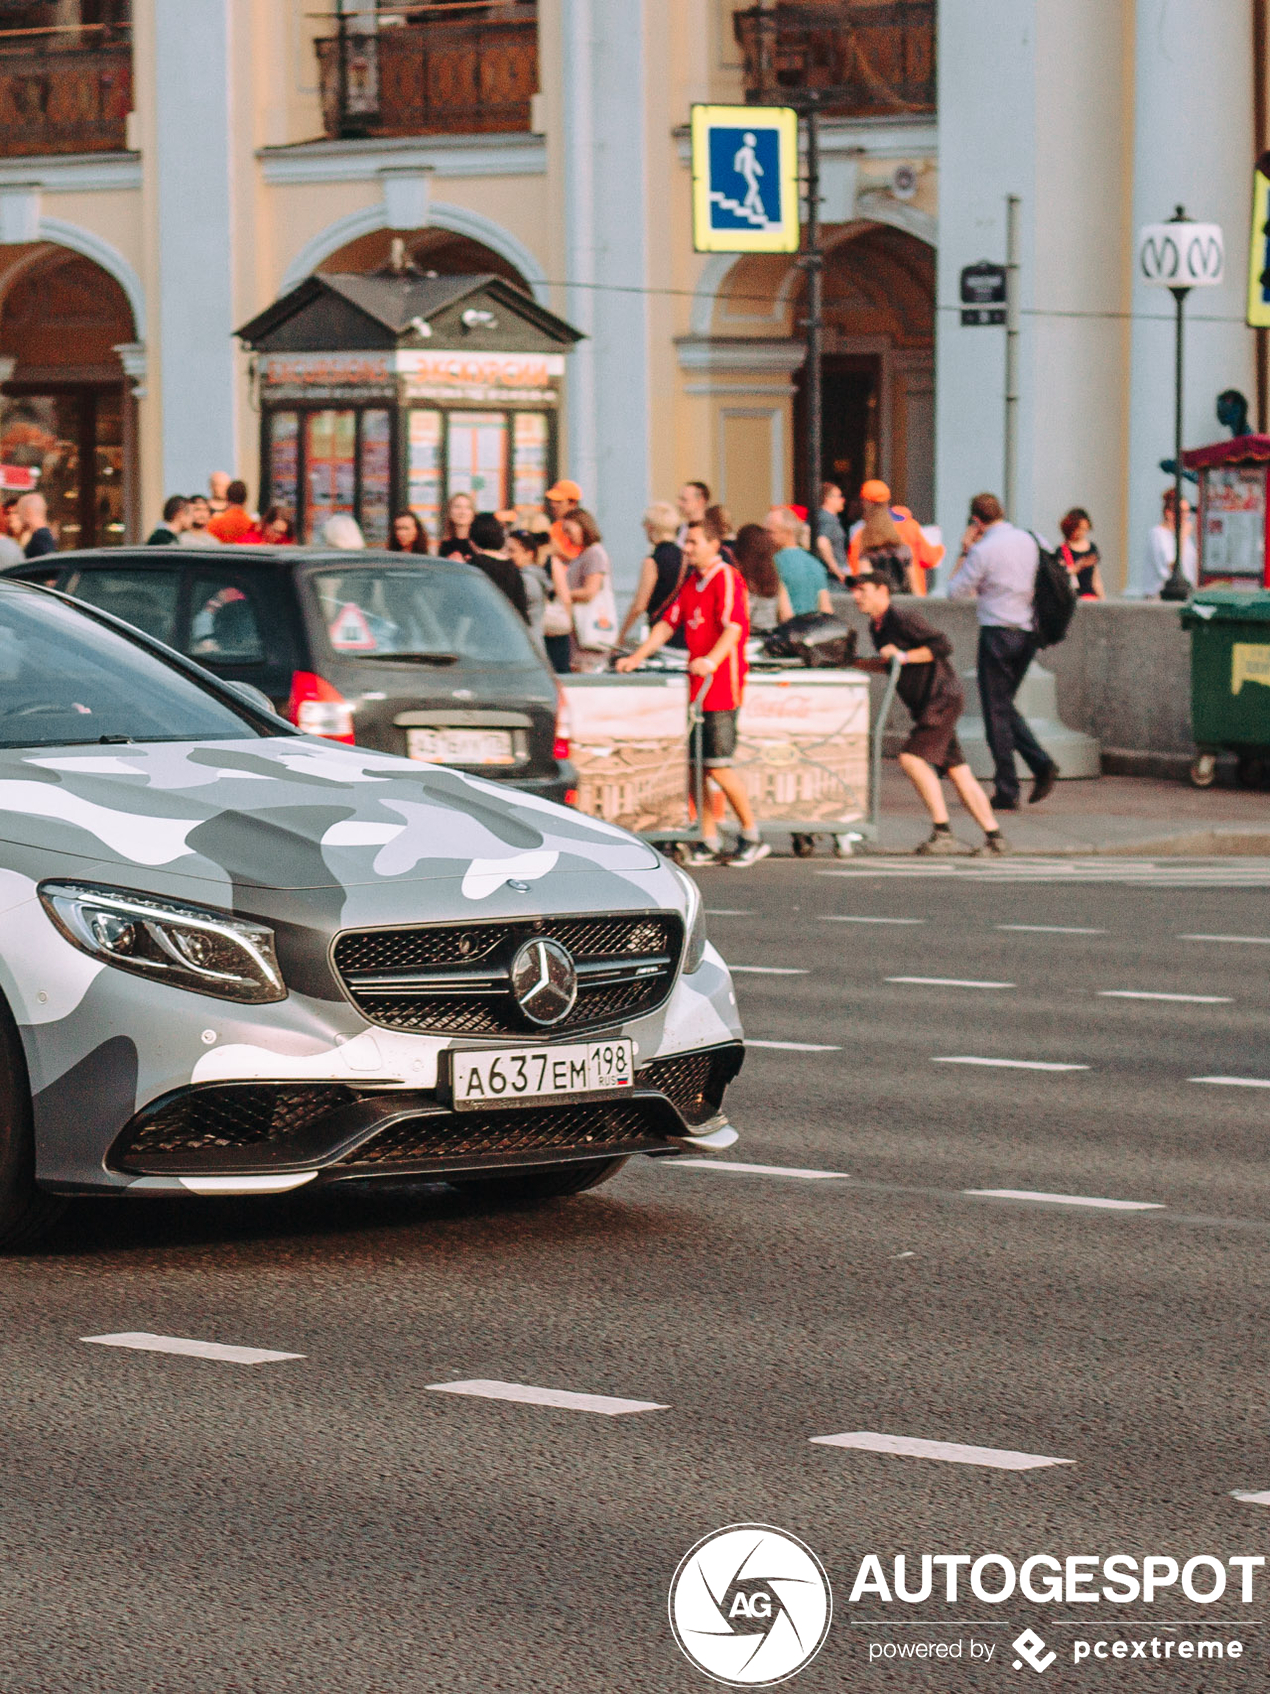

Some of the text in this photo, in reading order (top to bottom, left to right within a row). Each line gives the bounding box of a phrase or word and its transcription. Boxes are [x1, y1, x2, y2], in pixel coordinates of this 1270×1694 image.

[415, 358, 549, 386] ЭКСКУРСИИ
[591, 1046, 628, 1076] 198
[599, 1075, 617, 1086] RUS
